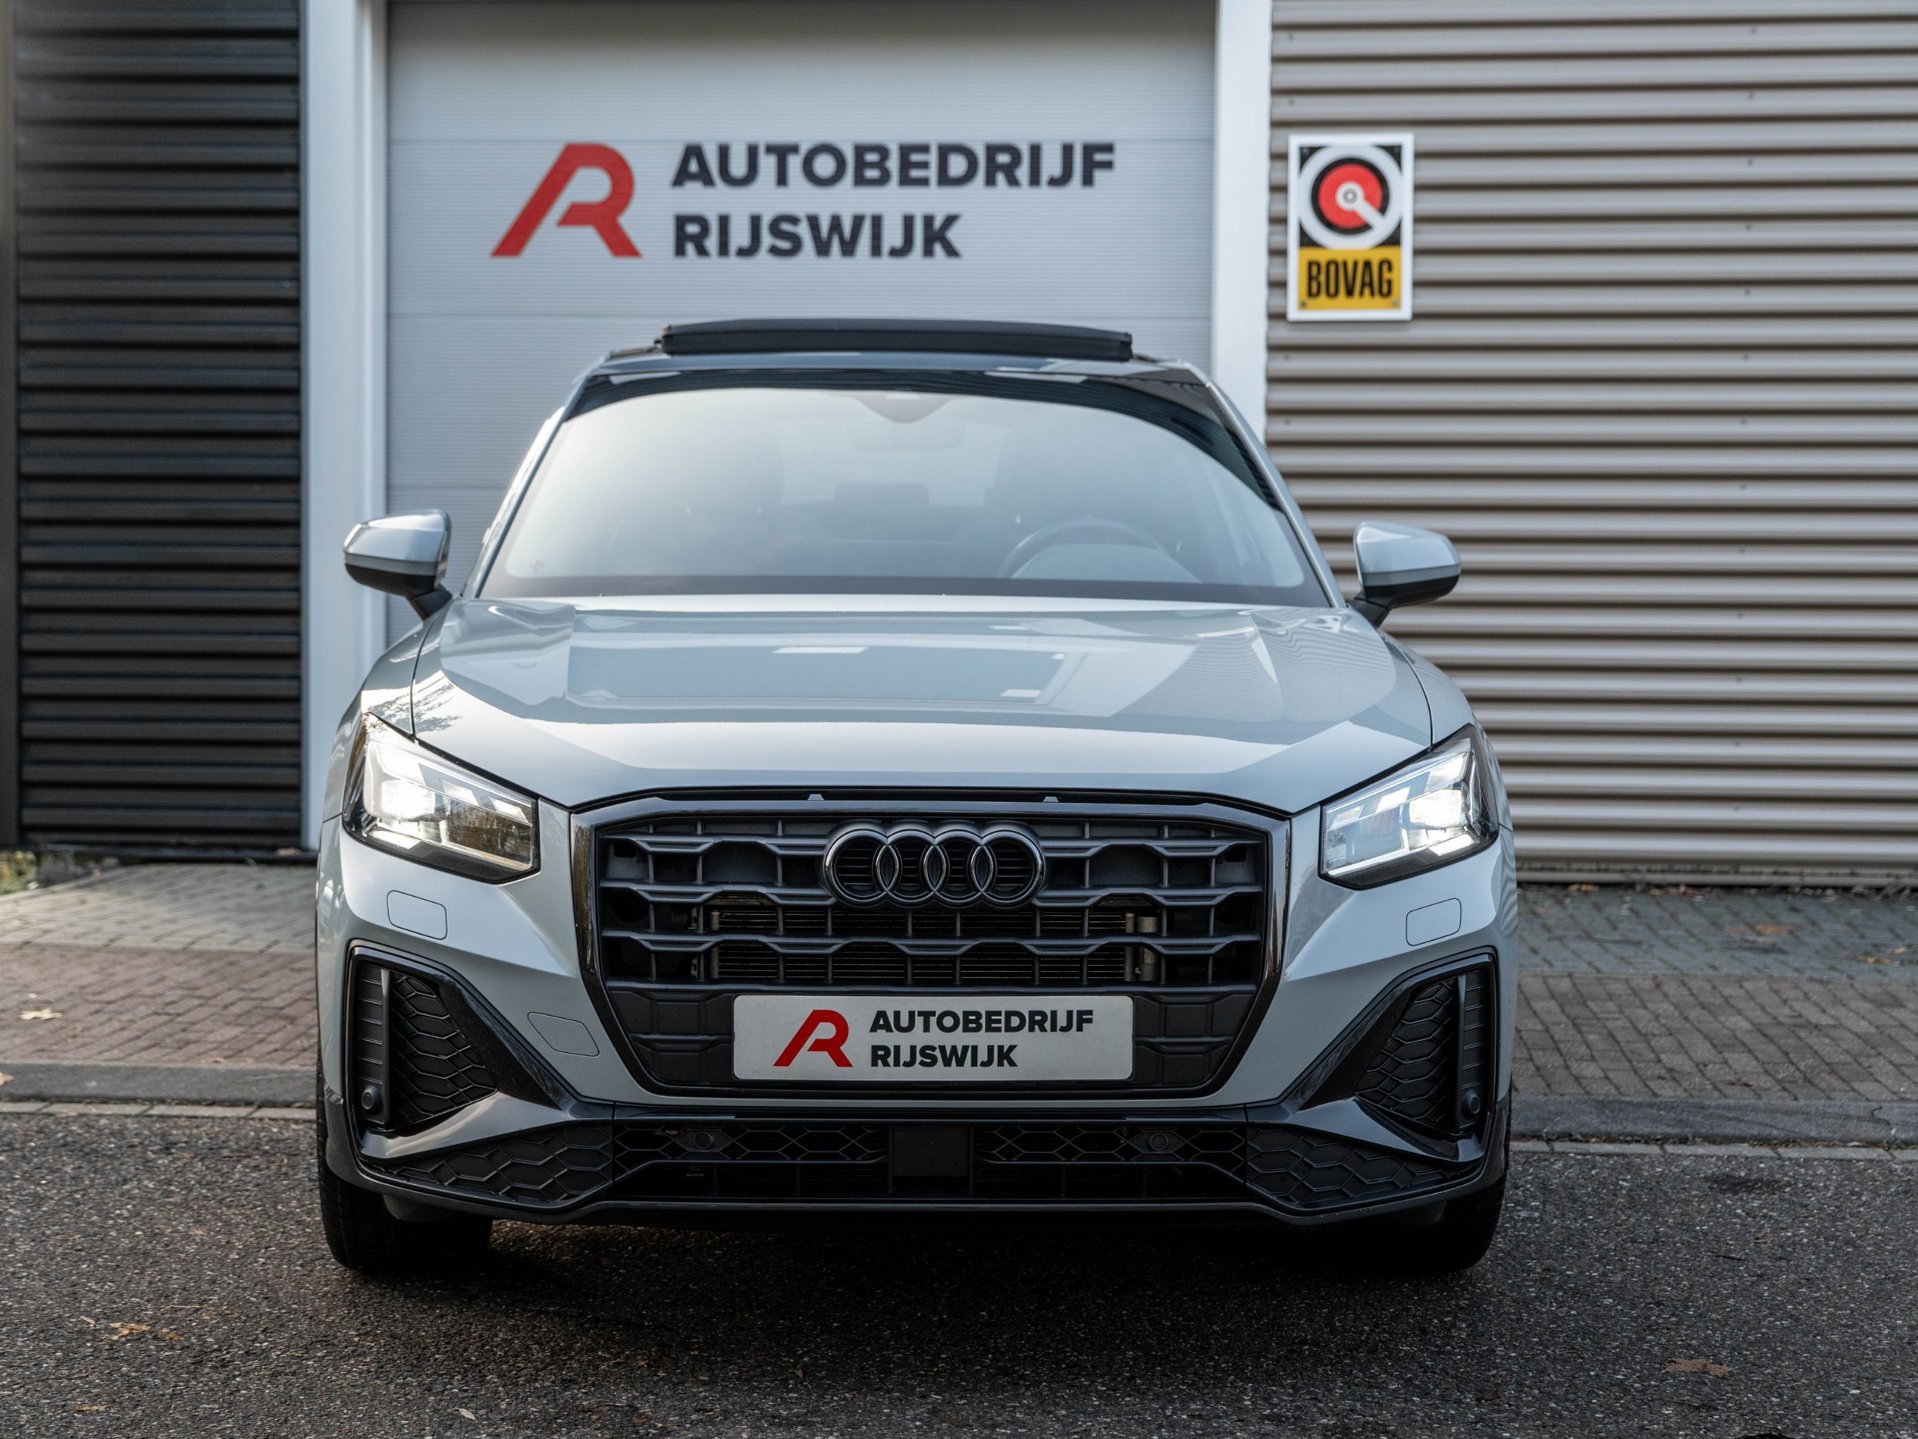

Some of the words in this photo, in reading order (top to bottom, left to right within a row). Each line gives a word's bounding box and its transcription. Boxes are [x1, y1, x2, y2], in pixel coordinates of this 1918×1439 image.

[671, 141, 1116, 188] AUTOBEDRIJF
[673, 213, 963, 259] RIJSWIJK
[1307, 259, 1393, 298] BOVAG
[869, 1008, 1094, 1033] AUTOBEDRIJF
[870, 1044, 1018, 1067] RIJSWIJK
